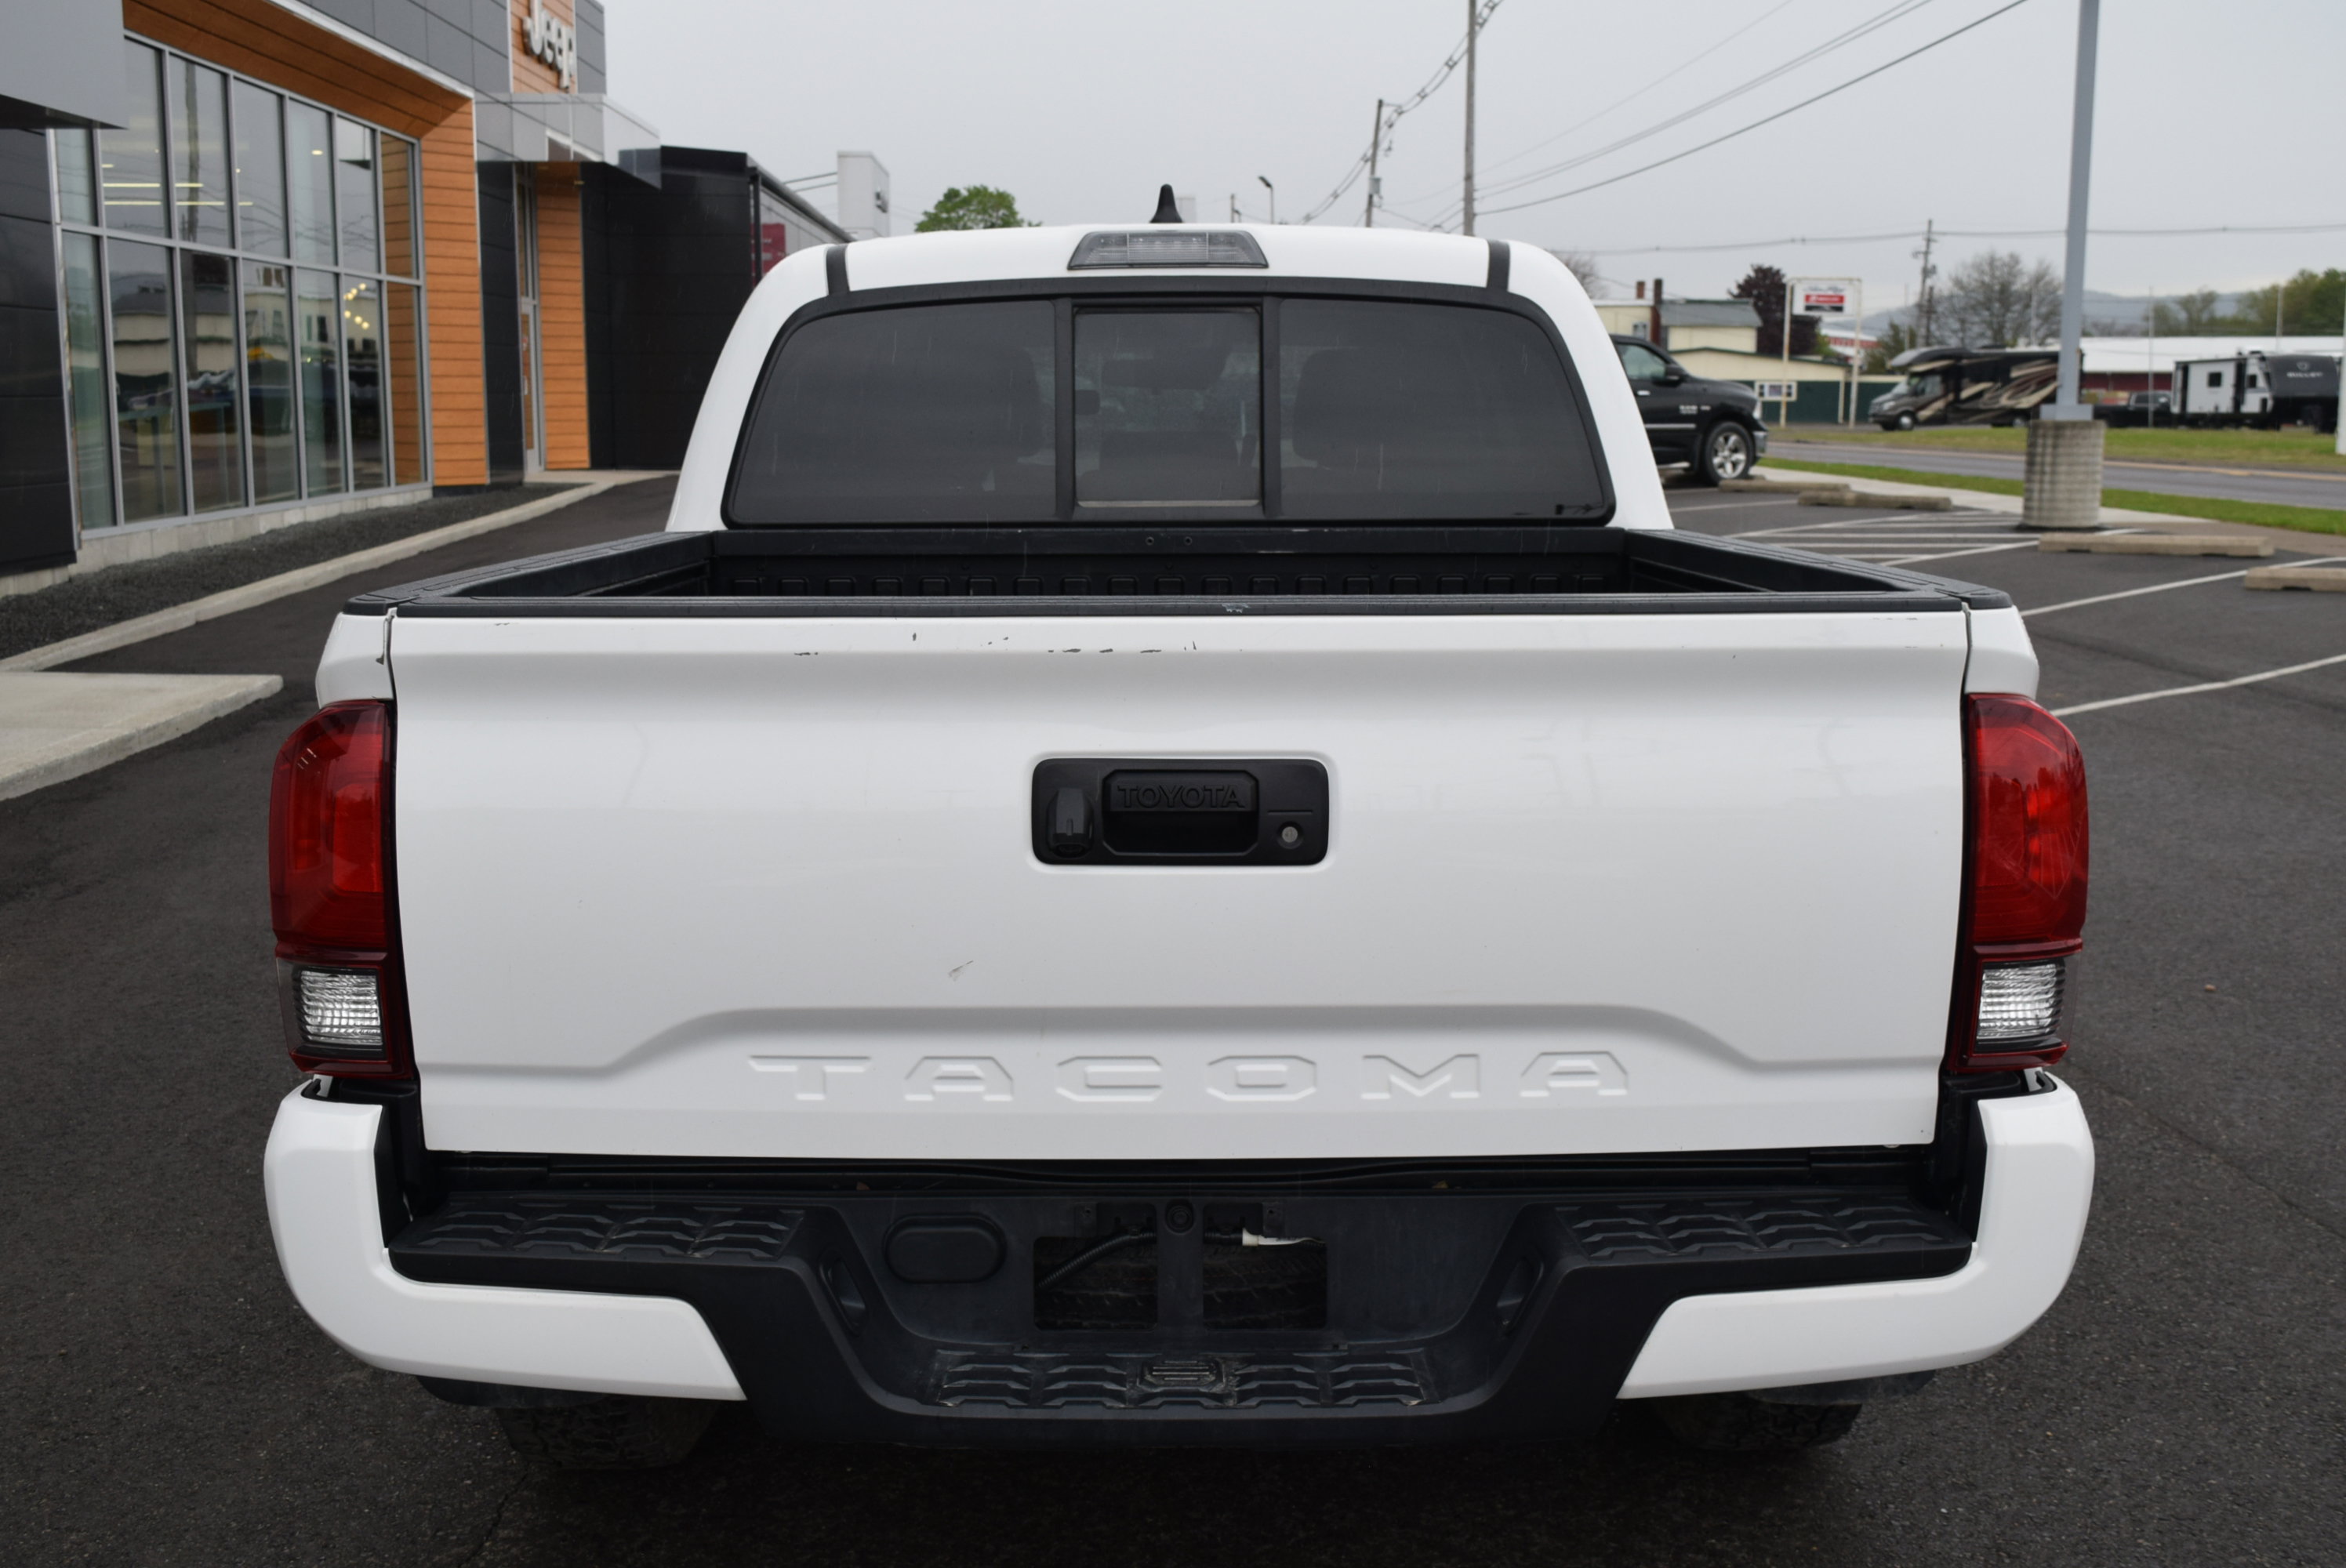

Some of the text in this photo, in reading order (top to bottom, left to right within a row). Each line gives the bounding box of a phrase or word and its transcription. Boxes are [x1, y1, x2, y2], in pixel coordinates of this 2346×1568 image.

[522, 0, 576, 89] Jeep
[1117, 785, 1245, 808] TOYOTA
[748, 1051, 1629, 1103] TACOMA
